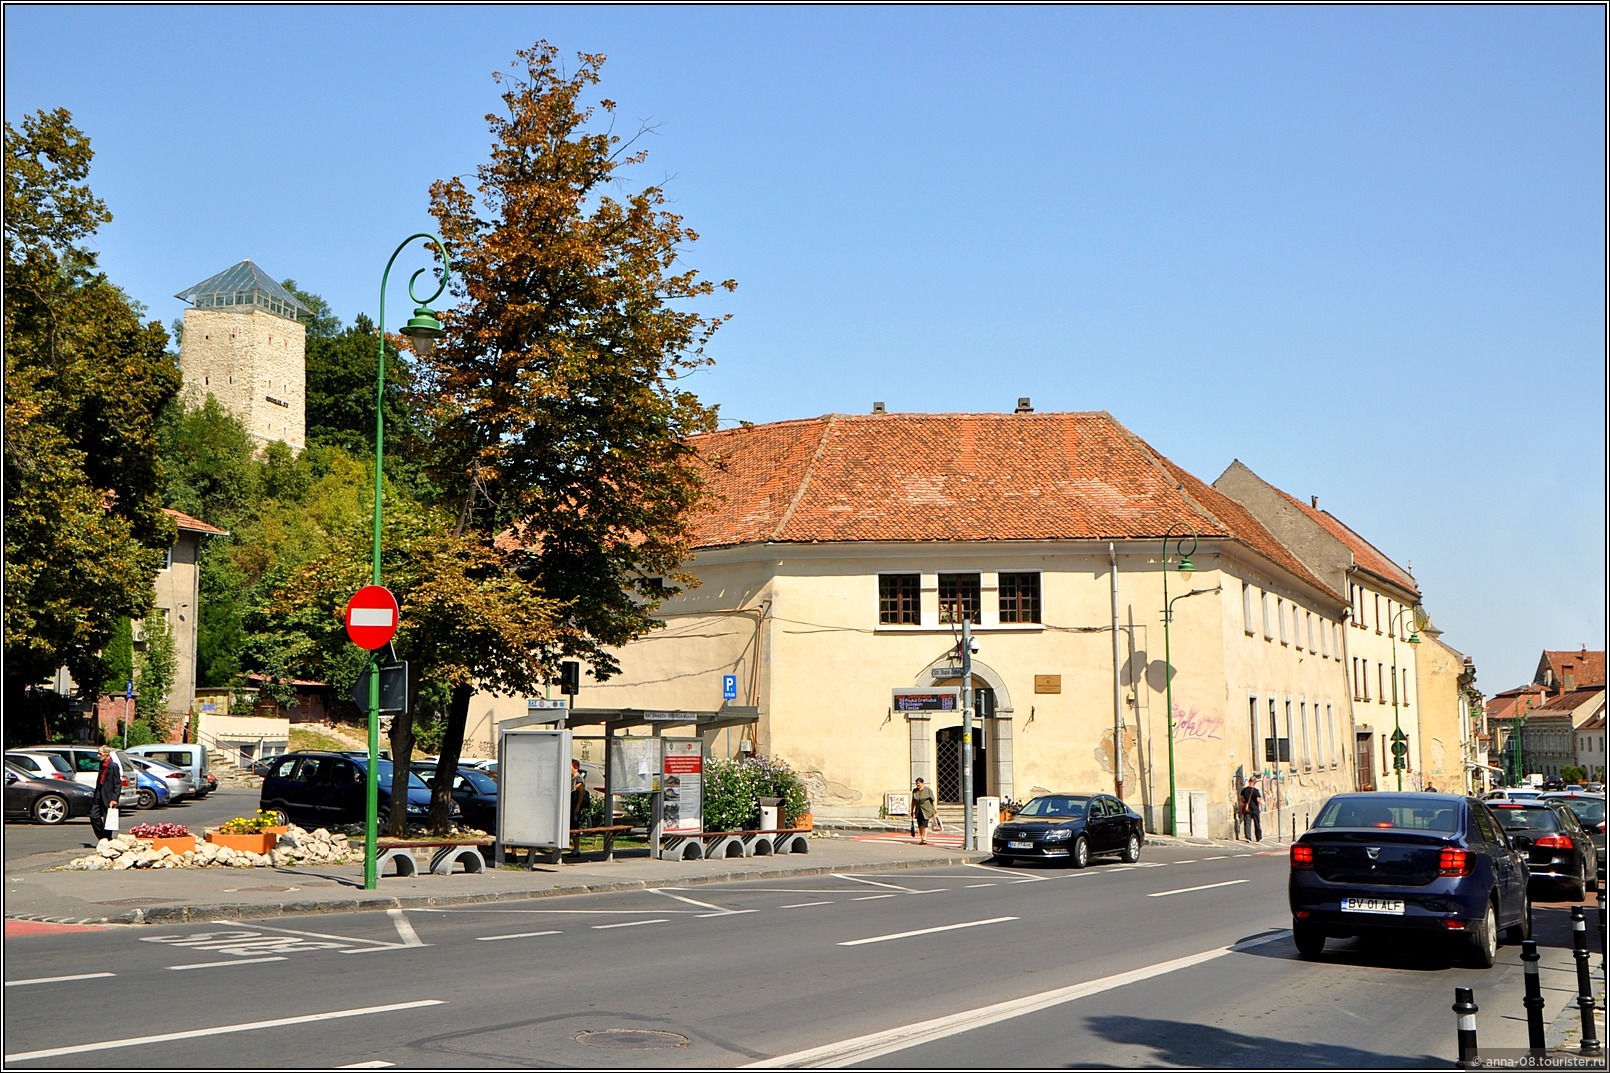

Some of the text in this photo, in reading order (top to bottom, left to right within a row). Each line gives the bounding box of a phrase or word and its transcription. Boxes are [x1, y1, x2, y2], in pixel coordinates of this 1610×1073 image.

[726, 677, 734, 692] P
[1348, 898, 1402, 911] BV 01 ALF
[138, 930, 355, 956] BUS
